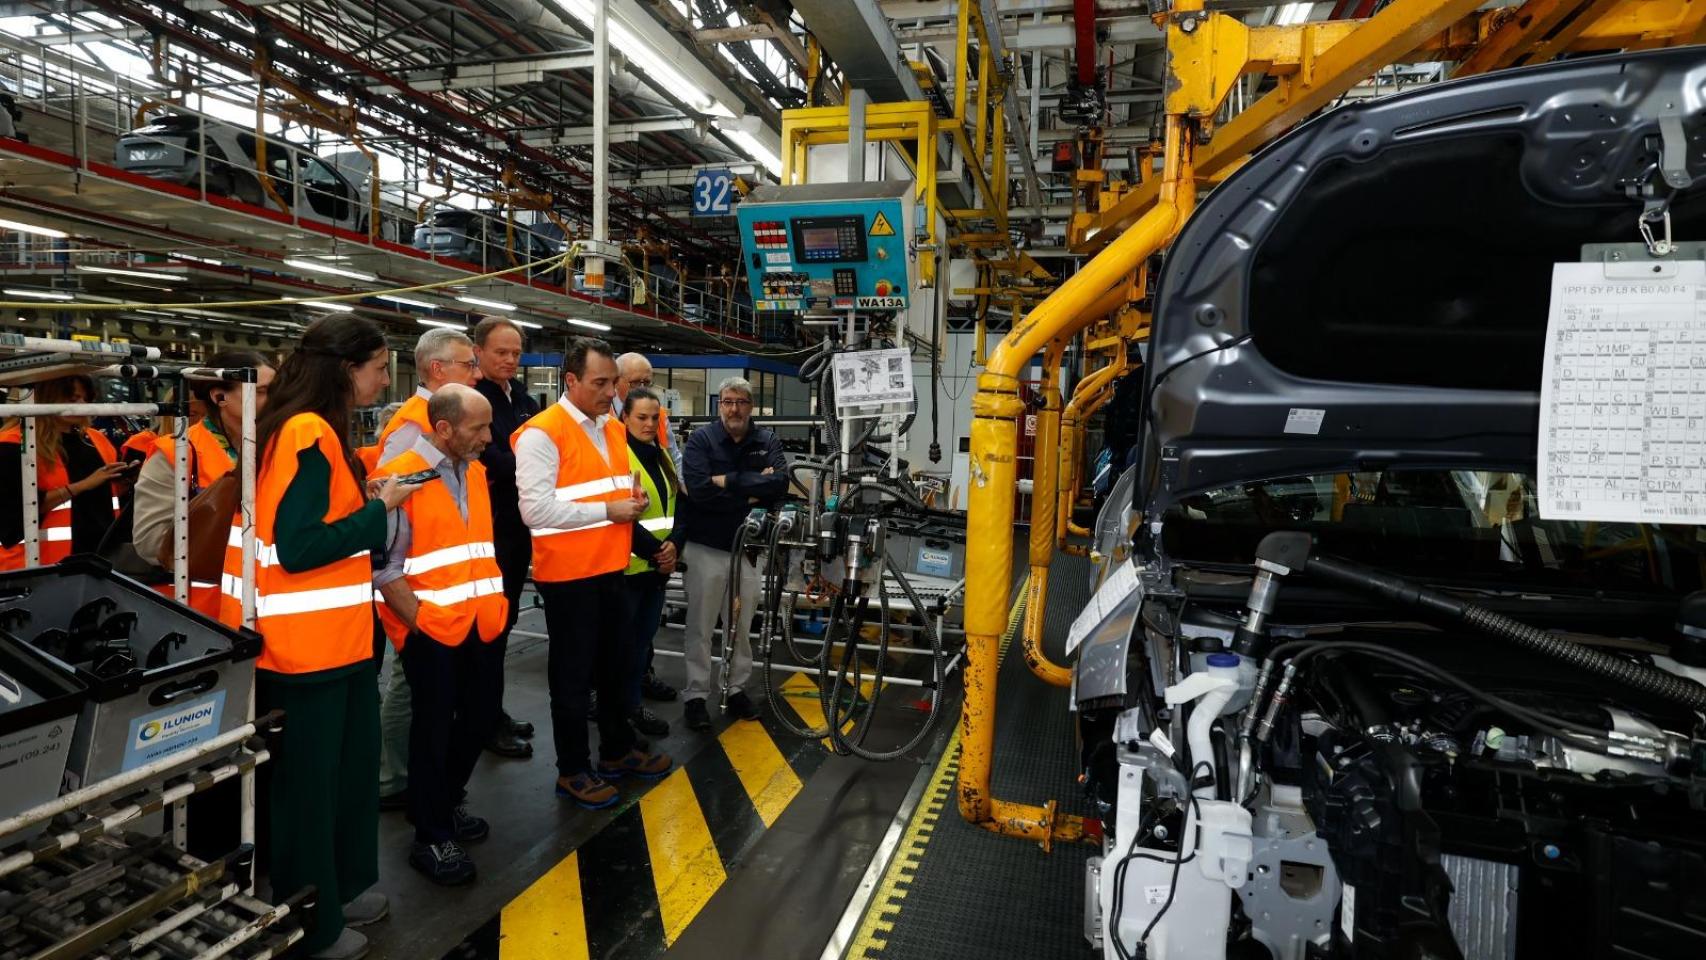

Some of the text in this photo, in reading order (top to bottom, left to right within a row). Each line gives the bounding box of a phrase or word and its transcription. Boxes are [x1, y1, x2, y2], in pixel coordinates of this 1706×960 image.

[695, 175, 729, 211] 32
[858, 298, 904, 308] WA13A
[163, 707, 212, 729] ILUNION
